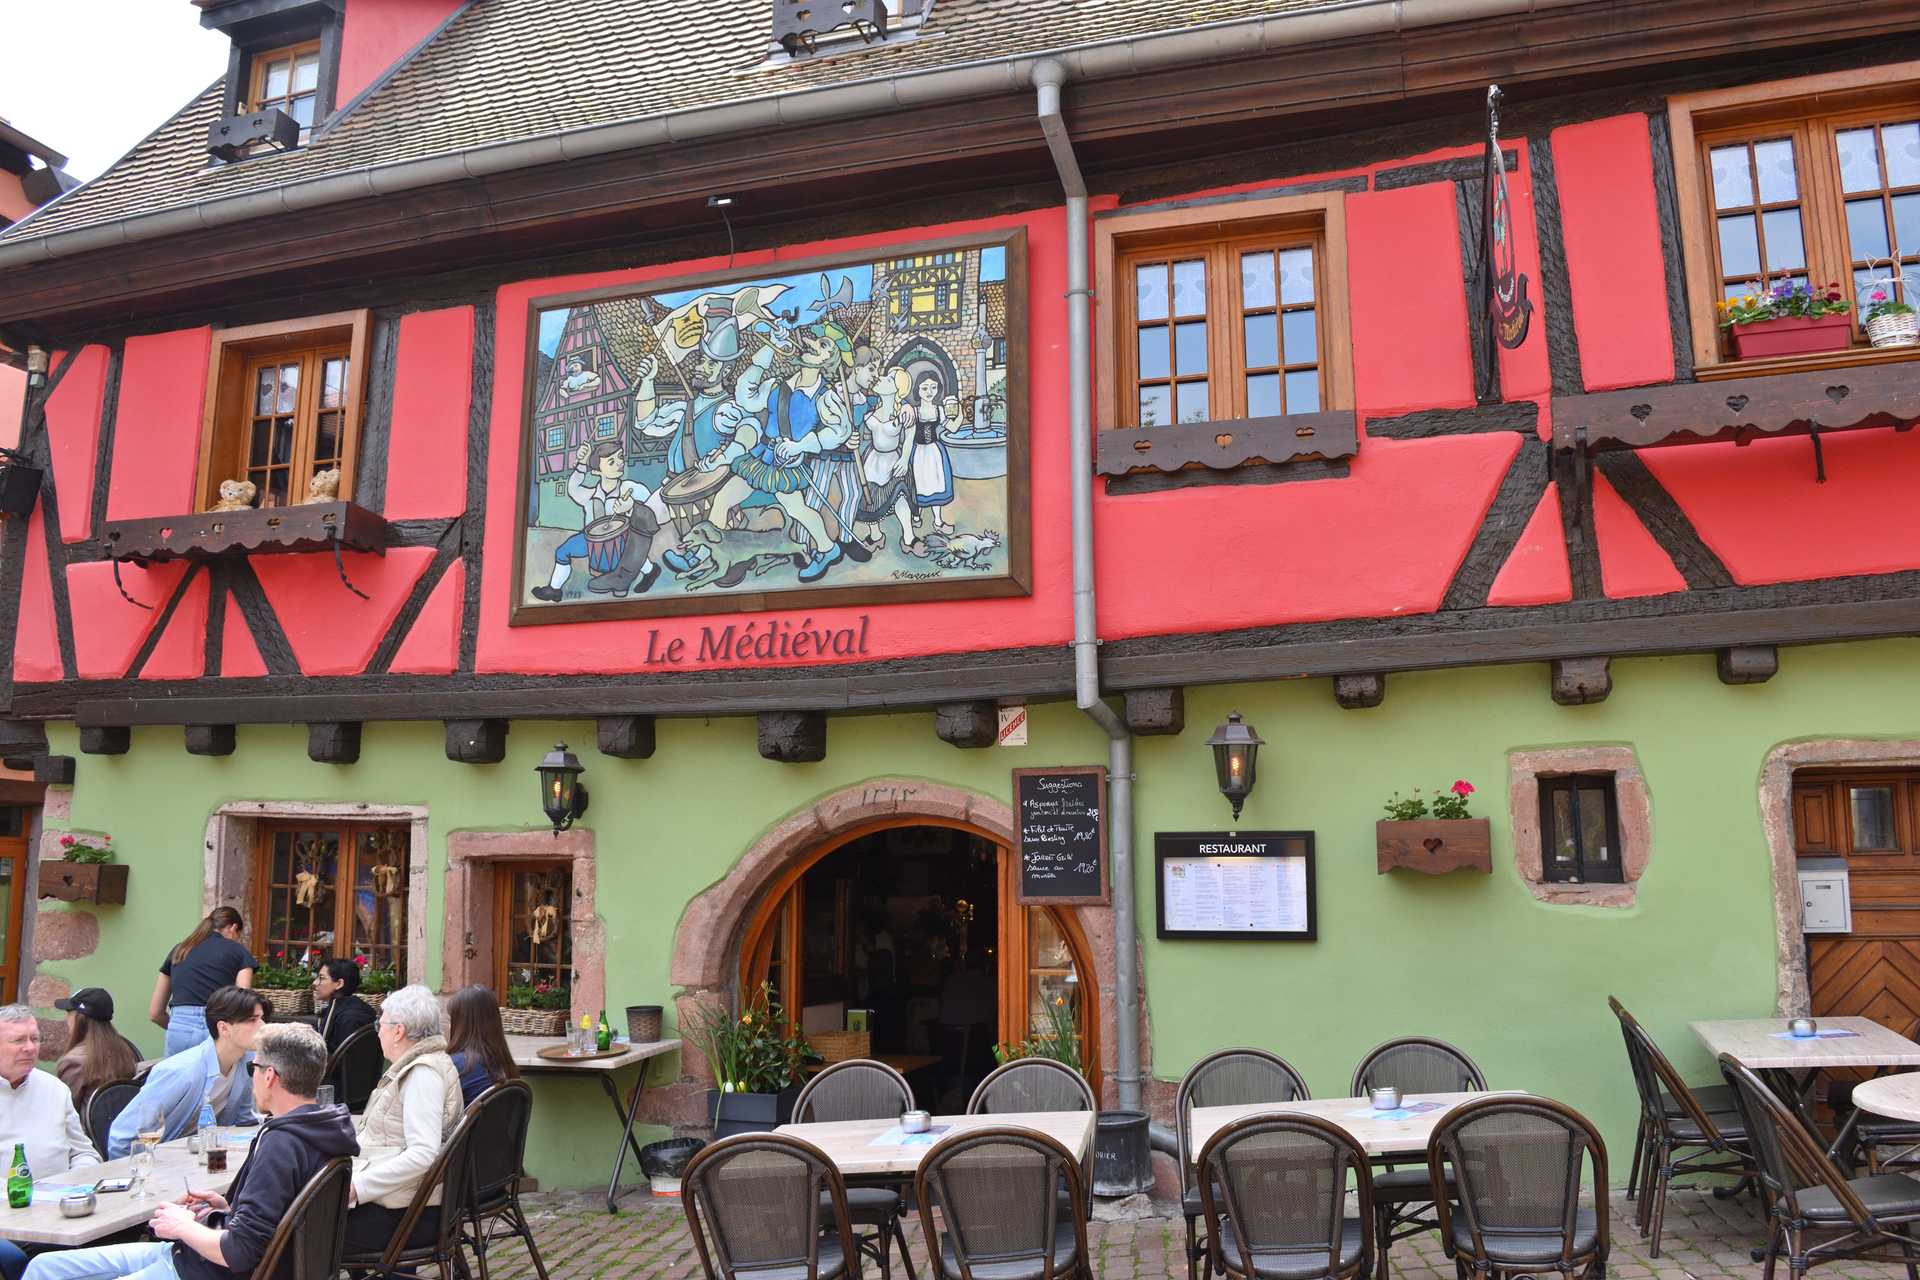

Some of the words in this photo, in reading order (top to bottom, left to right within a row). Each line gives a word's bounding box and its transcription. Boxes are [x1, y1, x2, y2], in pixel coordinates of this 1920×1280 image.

[644, 630, 685, 664] Le
[696, 615, 869, 662] Médiéval
[1000, 711, 1025, 741] LICENCE
[1037, 777, 1083, 793] Suggestions
[1199, 844, 1267, 854] RESTAURANT
